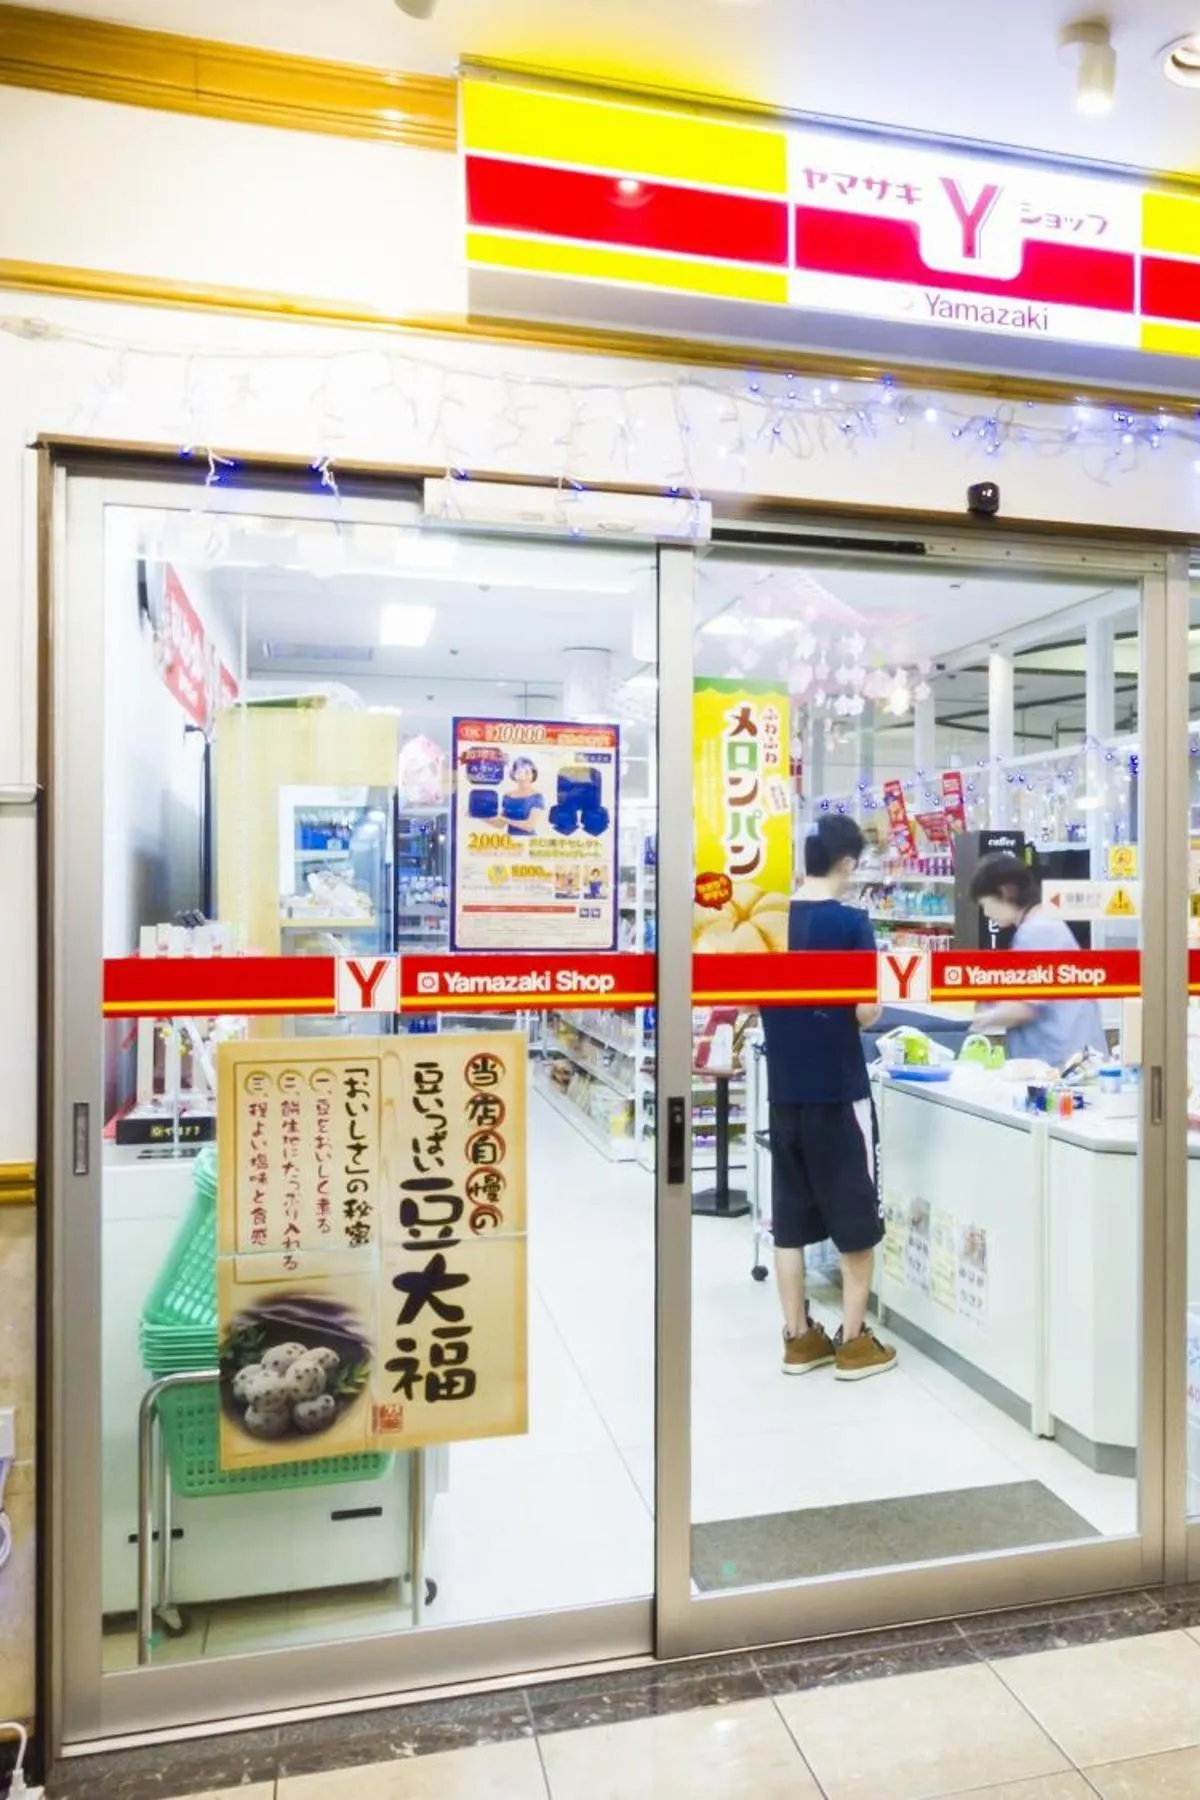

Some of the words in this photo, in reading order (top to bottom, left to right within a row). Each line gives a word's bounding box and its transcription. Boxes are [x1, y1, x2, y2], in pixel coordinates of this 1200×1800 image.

[939, 177, 1003, 259] Y
[925, 293, 1049, 331] Yamazaki
[763, 708, 779, 765] ふわふわ
[727, 707, 764, 876] メロンパン
[346, 960, 388, 1008] Y
[444, 971, 551, 993] Yamazaki
[556, 970, 615, 994] Shop
[886, 956, 921, 999] Y
[966, 965, 1053, 985] Yamazaki
[1057, 965, 1106, 986] Shop
[411, 1061, 449, 1173] 豆いっぱい
[467, 1055, 505, 1234] 当店自慢の
[343, 1068, 372, 1248] 「おいしさ」の秘密
[385, 1176, 477, 1403] 豆大福
